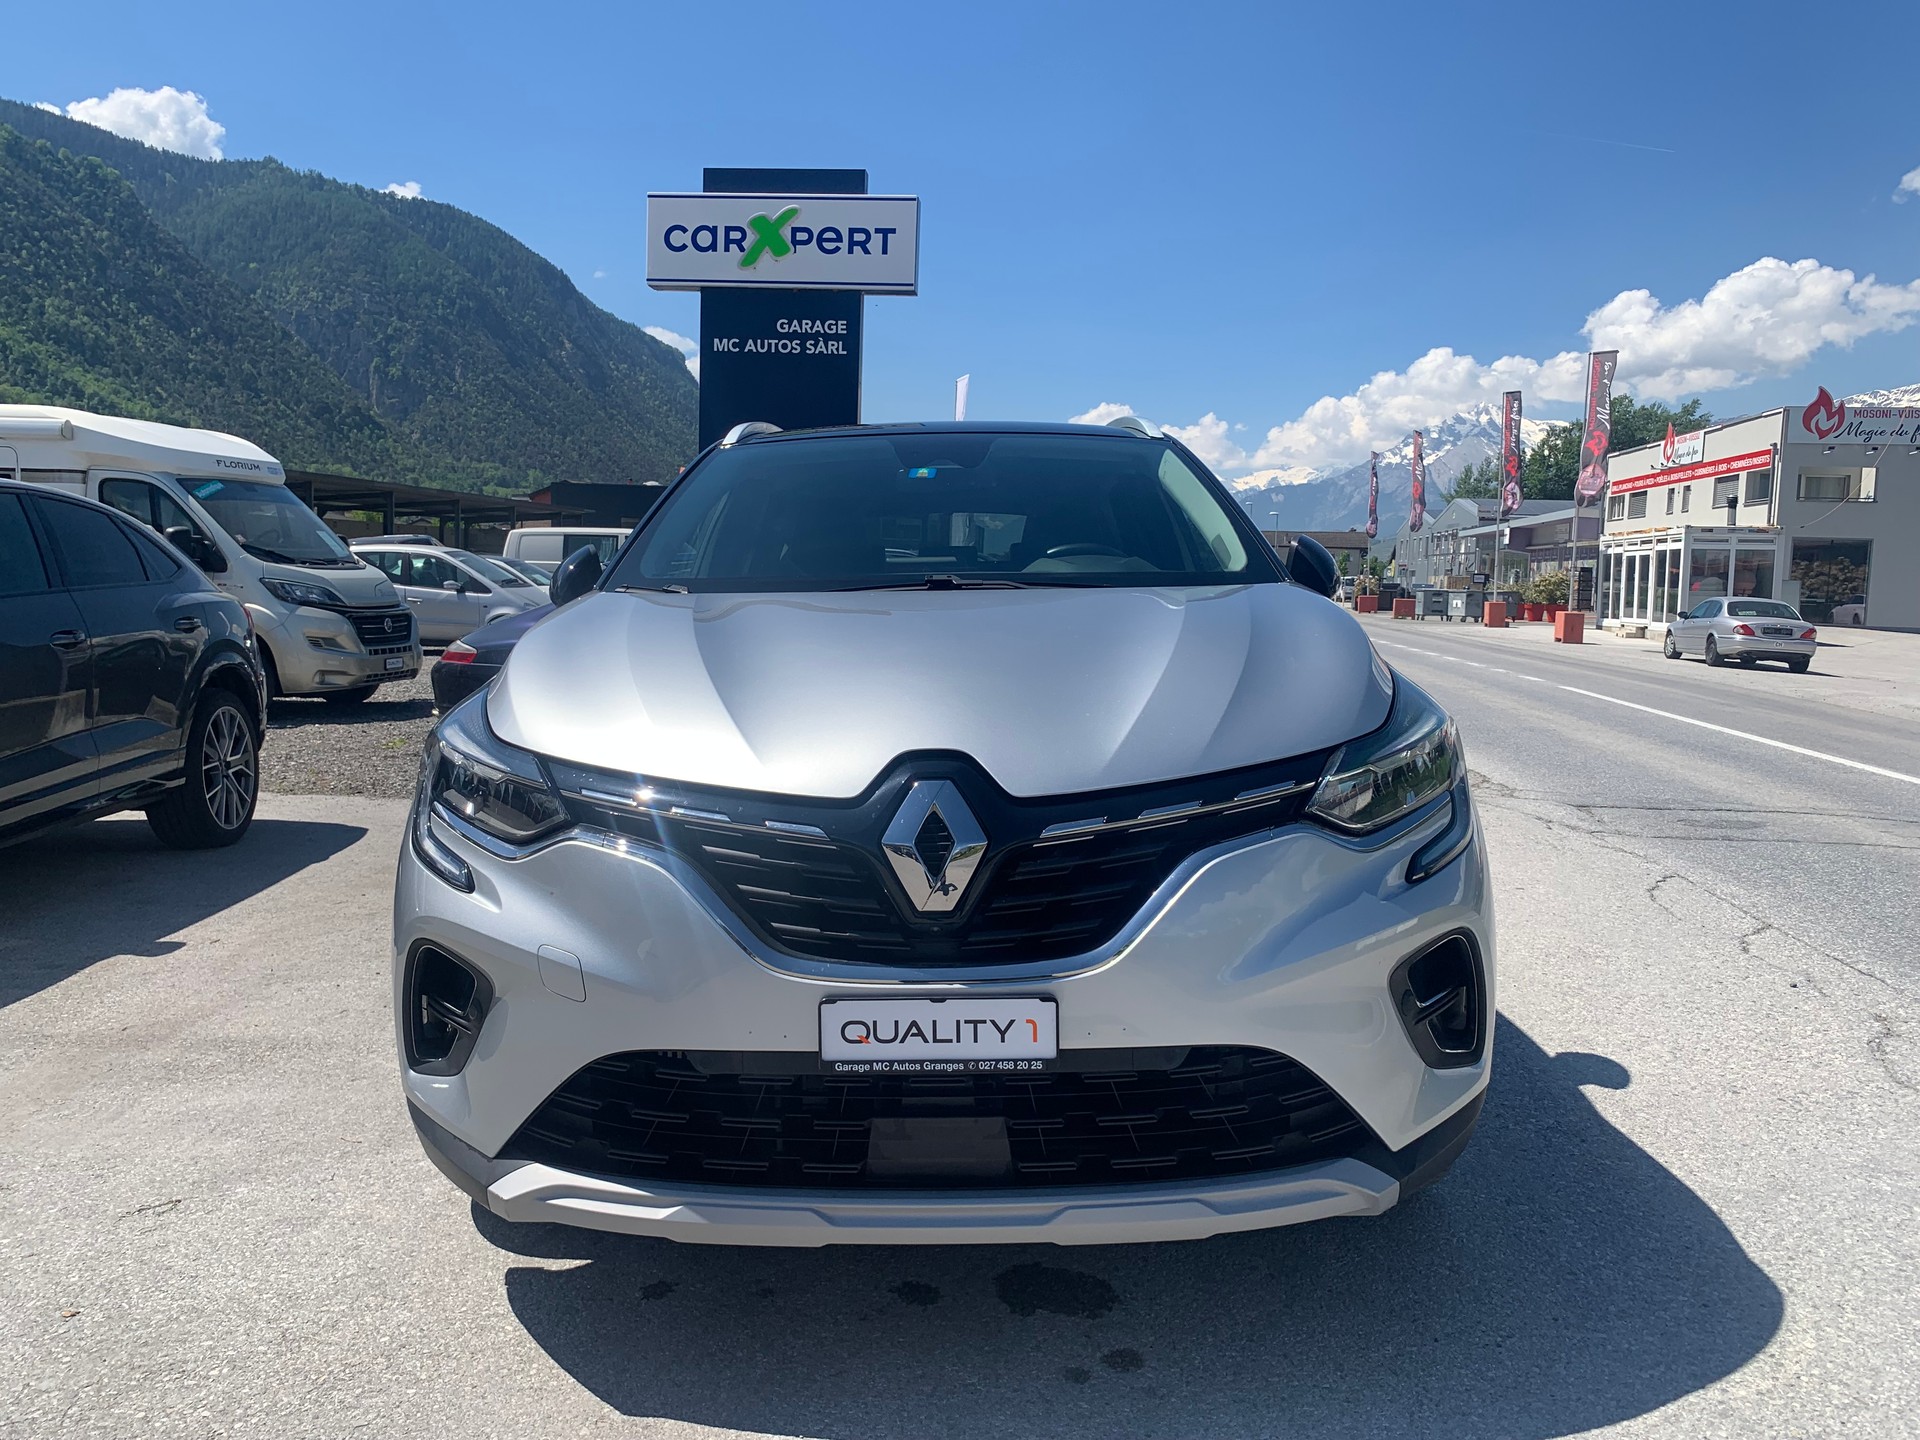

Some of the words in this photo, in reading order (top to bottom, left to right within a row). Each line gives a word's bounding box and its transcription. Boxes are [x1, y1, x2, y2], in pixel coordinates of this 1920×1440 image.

[776, 318, 848, 334] GARAGE
[713, 338, 740, 352] MC
[744, 338, 801, 354] AUTOS
[805, 337, 847, 355] SÀRL
[1833, 420, 1887, 443] Magie
[1890, 423, 1909, 437] du
[216, 459, 261, 471] FLORIUM
[840, 1019, 1016, 1044] QUALITY
[1025, 1018, 1038, 1043] 1
[835, 1062, 870, 1072] Garage
[873, 1062, 892, 1071] MC
[892, 1062, 920, 1071] Autos
[923, 1061, 964, 1072] Granges
[978, 1061, 996, 1070] 027
[997, 1061, 1014, 1070] 458
[1017, 1061, 1029, 1070] 20
[1030, 1060, 1043, 1070] 25
